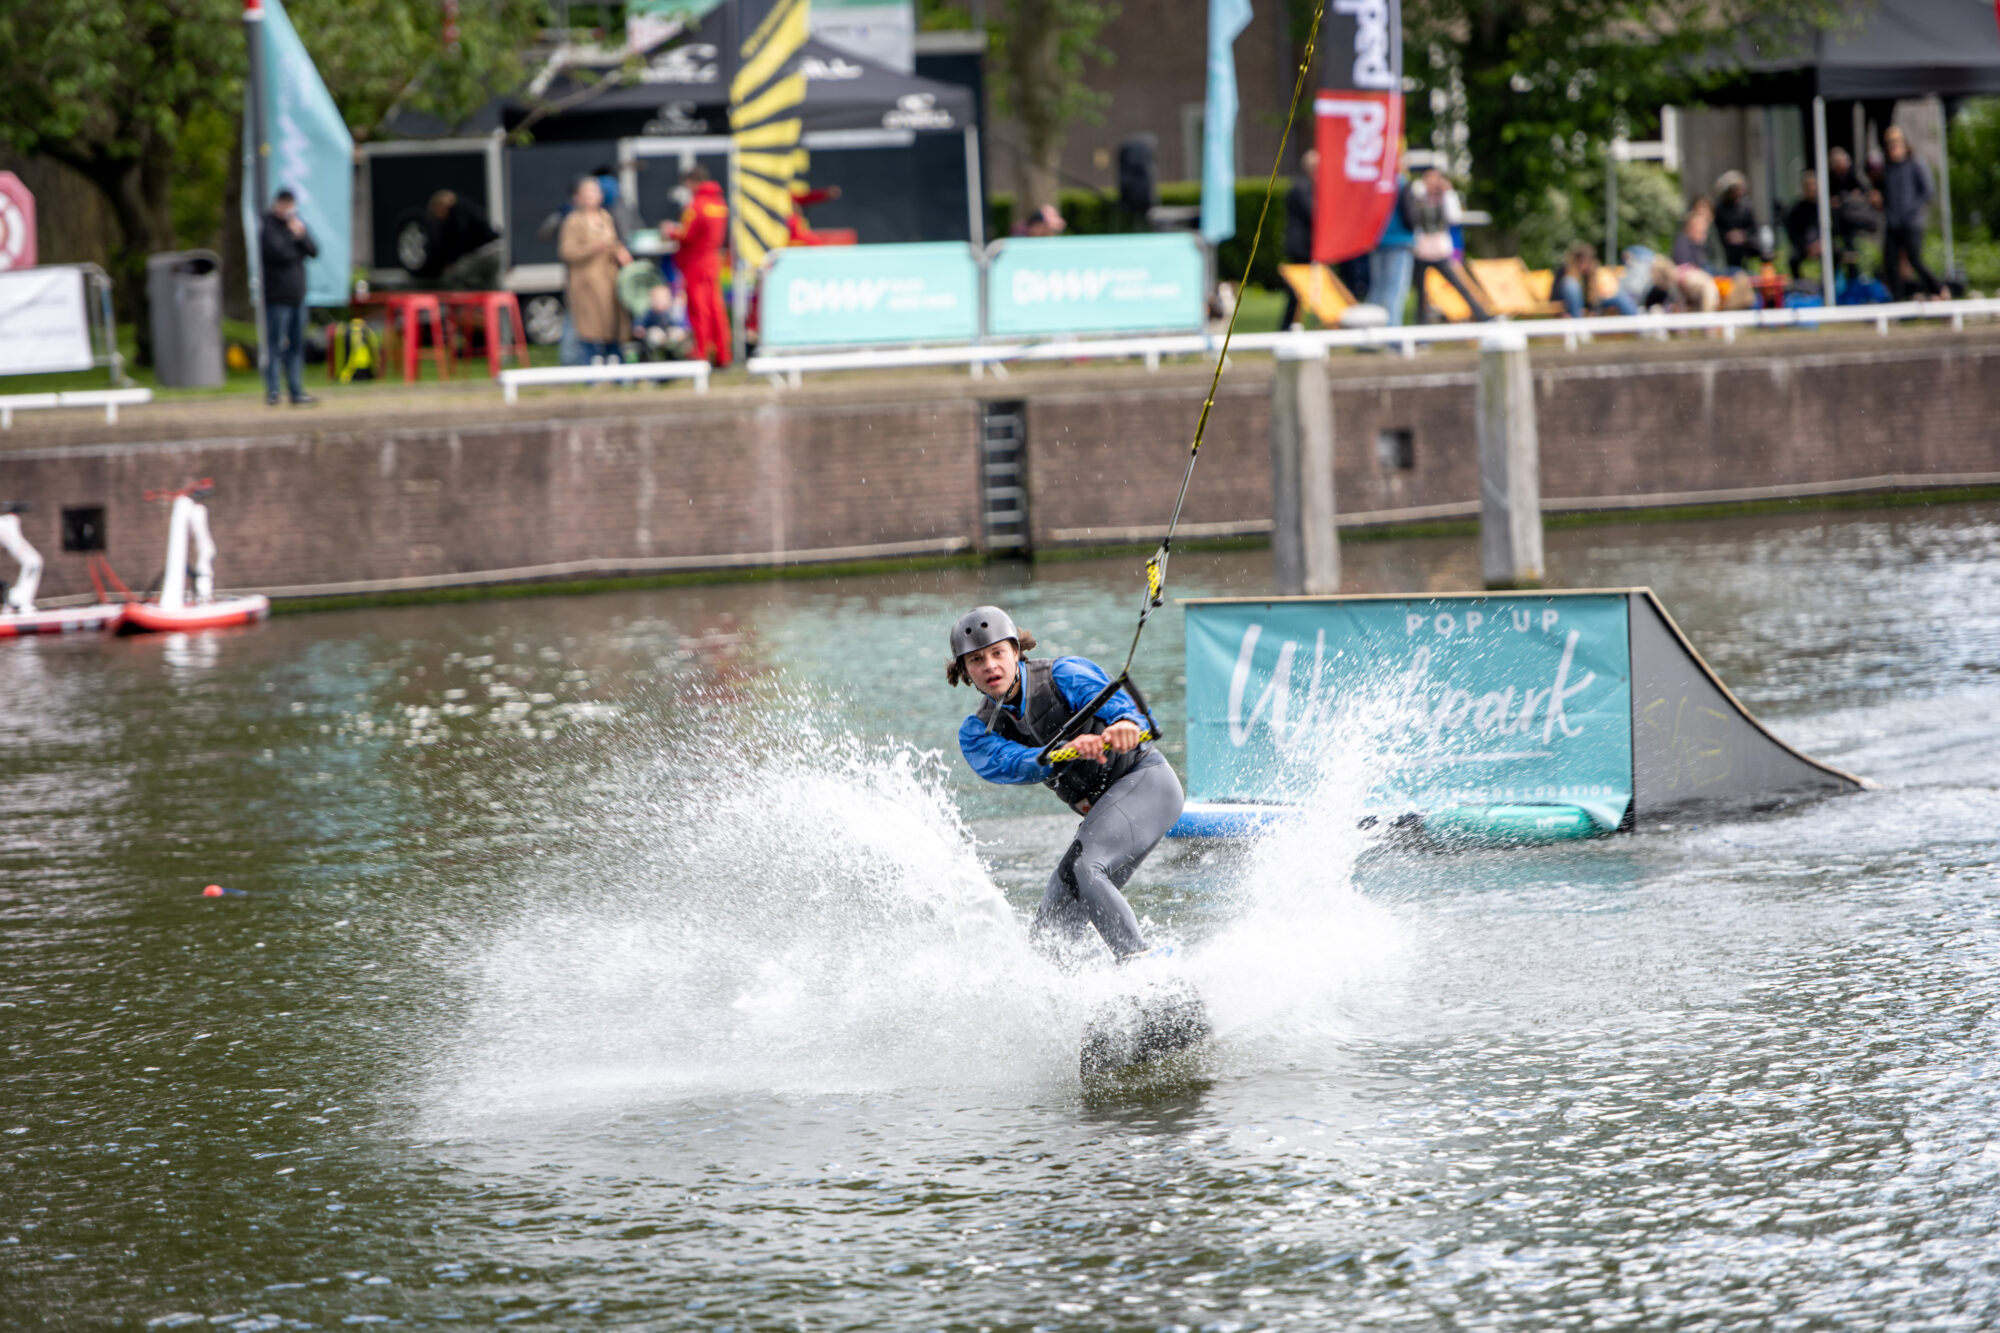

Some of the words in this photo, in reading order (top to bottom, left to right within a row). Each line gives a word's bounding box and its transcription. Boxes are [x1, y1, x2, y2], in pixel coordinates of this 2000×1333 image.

[1406, 611, 1483, 636] POP
[1512, 609, 1559, 633] UP
[1523, 784, 1613, 799] LOCATION
